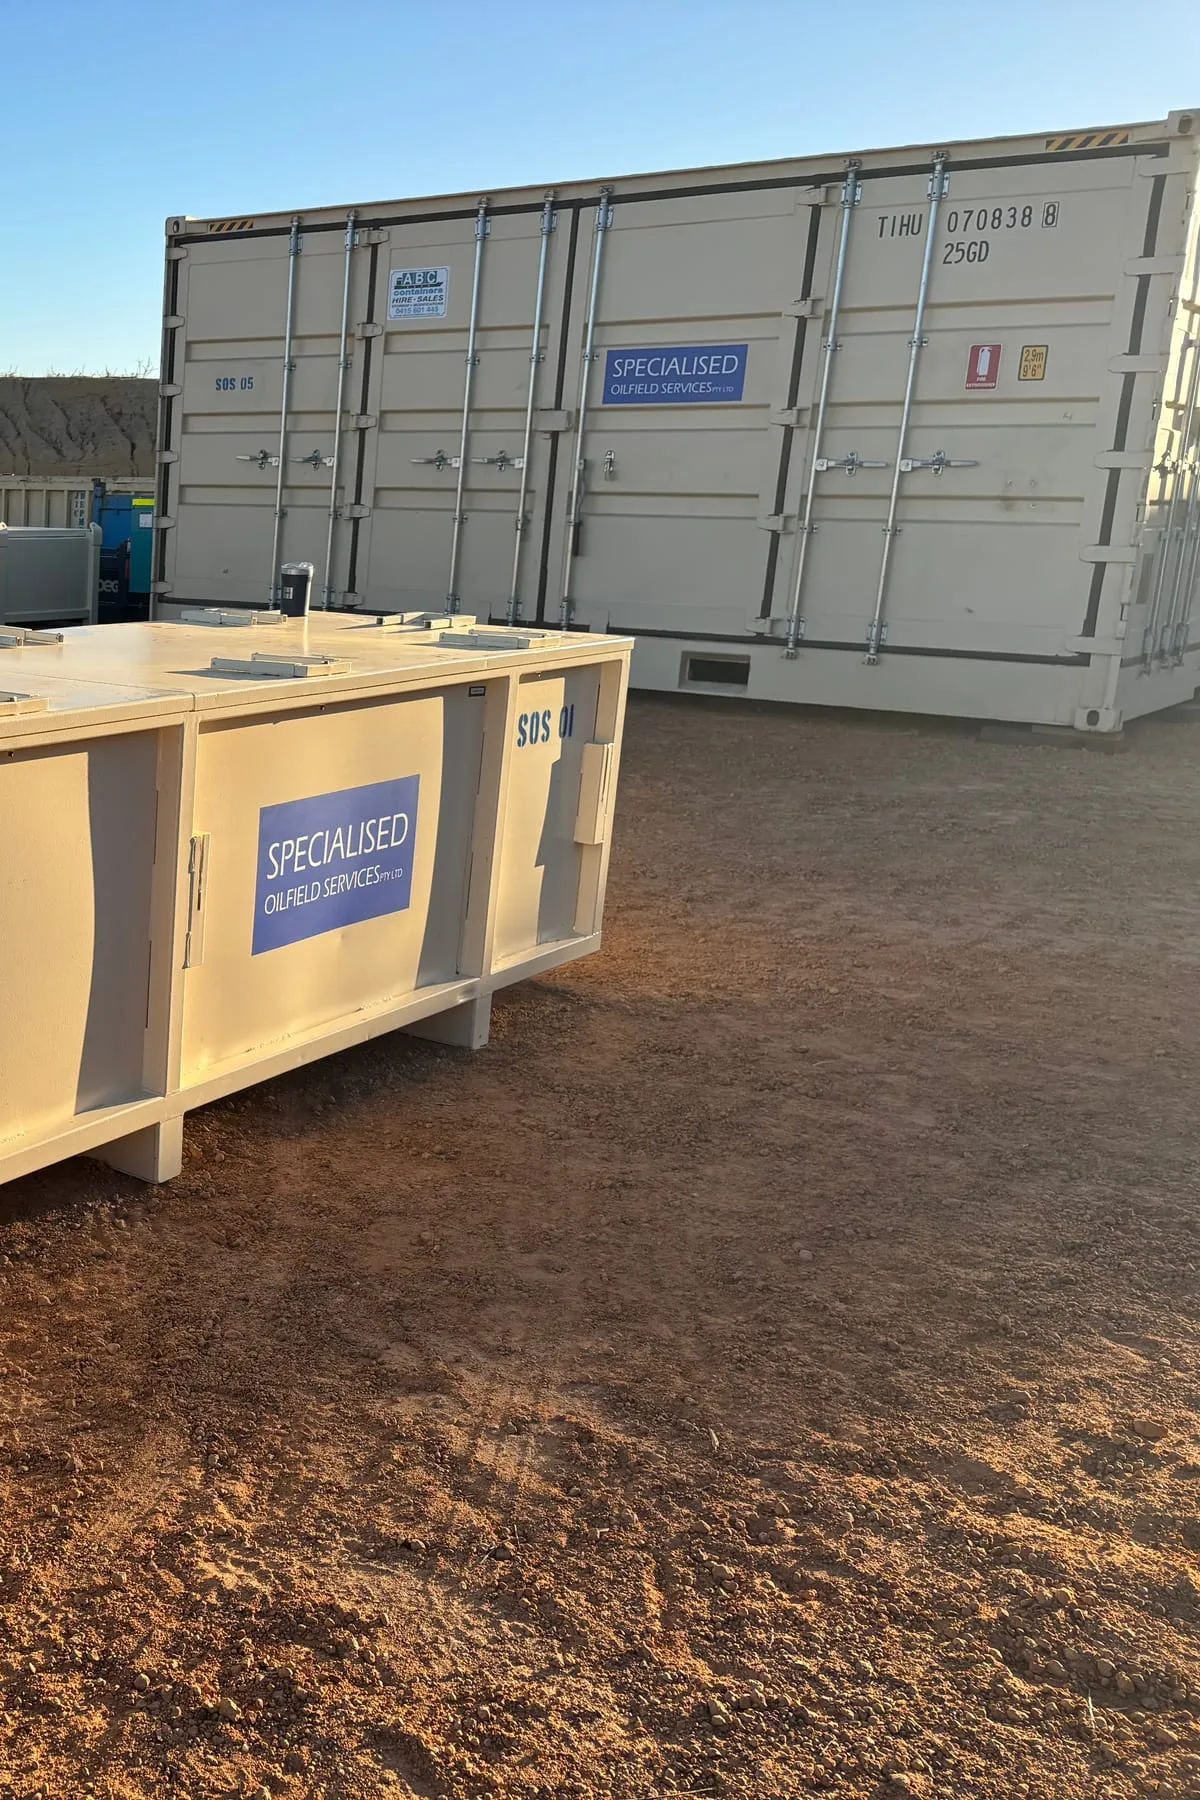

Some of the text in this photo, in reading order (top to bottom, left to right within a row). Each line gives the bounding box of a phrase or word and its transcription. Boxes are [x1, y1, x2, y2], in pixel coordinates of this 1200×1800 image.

[878, 203, 1057, 238] TIHU 070838 8
[942, 240, 989, 265] 25GD
[403, 271, 437, 285] ABC
[612, 355, 738, 377] SPECIALISED
[215, 376, 254, 391] SOS 05
[611, 383, 659, 395] OILFIELD
[661, 382, 712, 394] SERVICES
[517, 704, 575, 748] SOS 01
[266, 812, 409, 880] SPECIALISED
[264, 865, 403, 915] OILFIELD SERVICES PTY LTD
